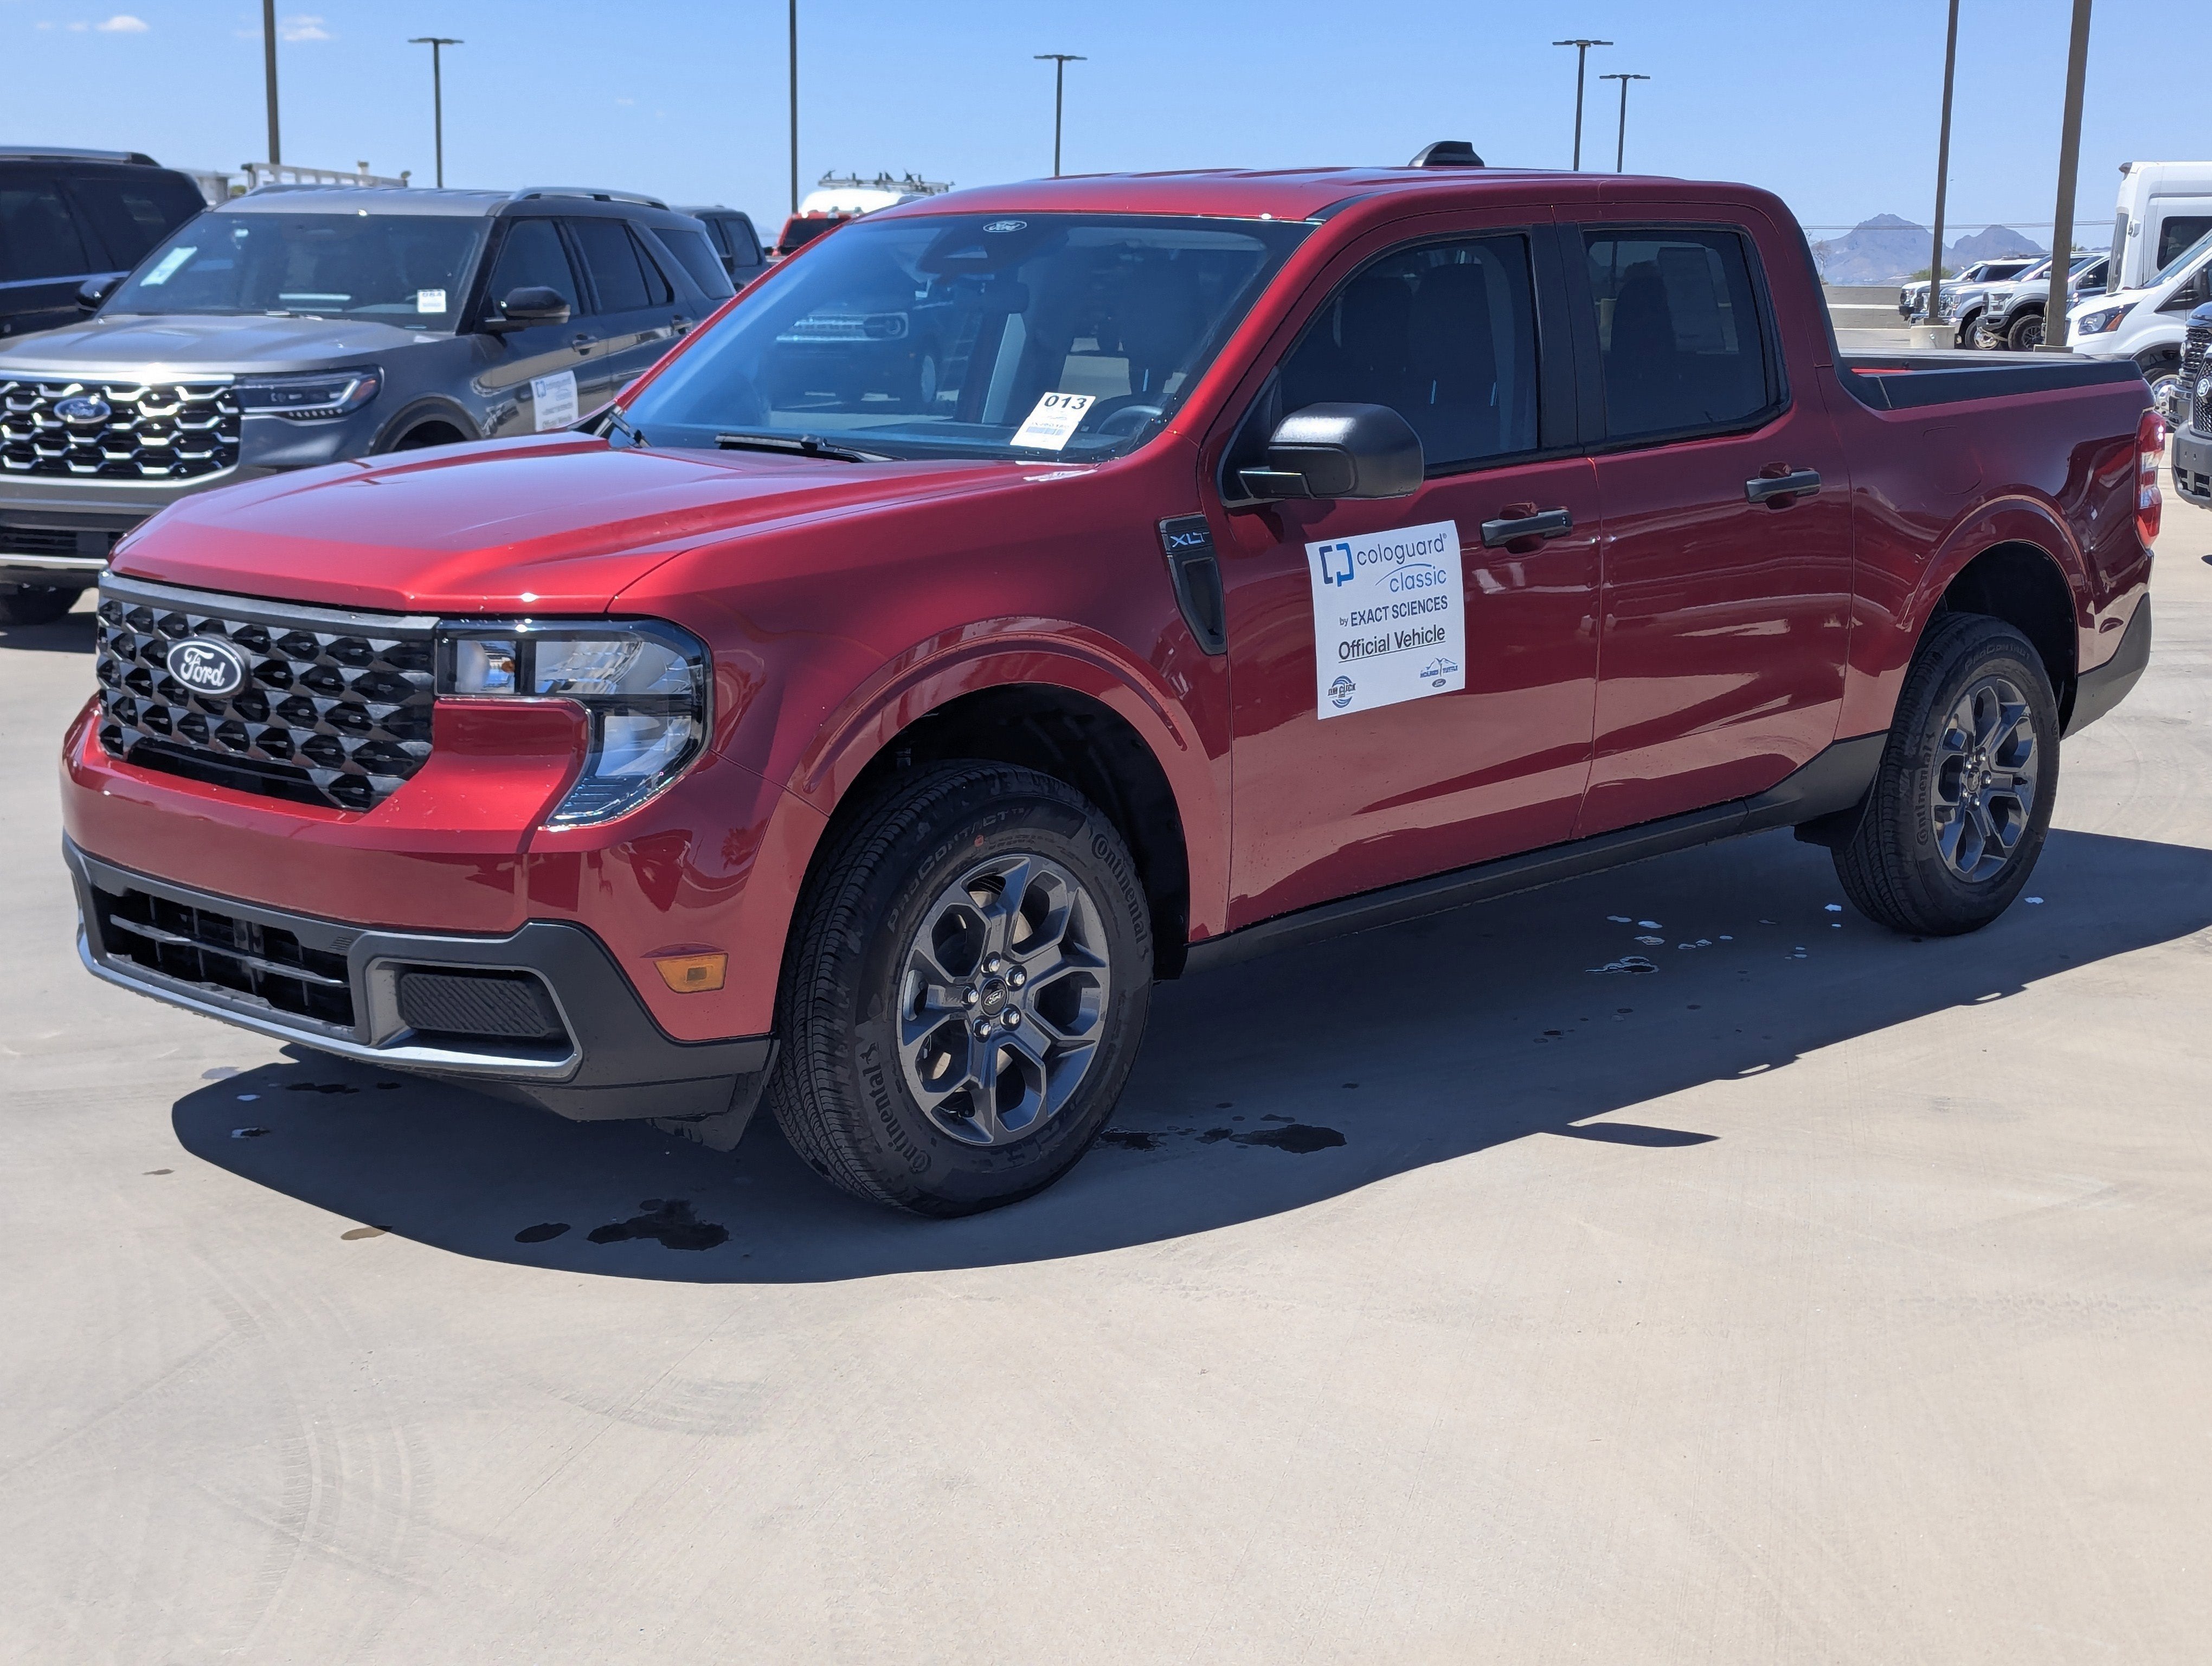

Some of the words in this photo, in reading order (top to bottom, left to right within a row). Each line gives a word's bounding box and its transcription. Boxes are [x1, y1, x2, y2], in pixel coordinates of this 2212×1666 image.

[1044, 395, 1087, 409] 013
[1170, 531, 1210, 548] XLT
[1390, 566, 1447, 593] classic
[1339, 617, 1349, 627] by
[1351, 605, 1390, 627] EXACT
[1392, 595, 1448, 619] SCIENCES
[1339, 633, 1390, 660] Official
[1394, 624, 1445, 649] Vehicle
[181, 647, 226, 687] Ford
[1091, 834, 1148, 945] Continental
[862, 1062, 932, 1175] Continental
